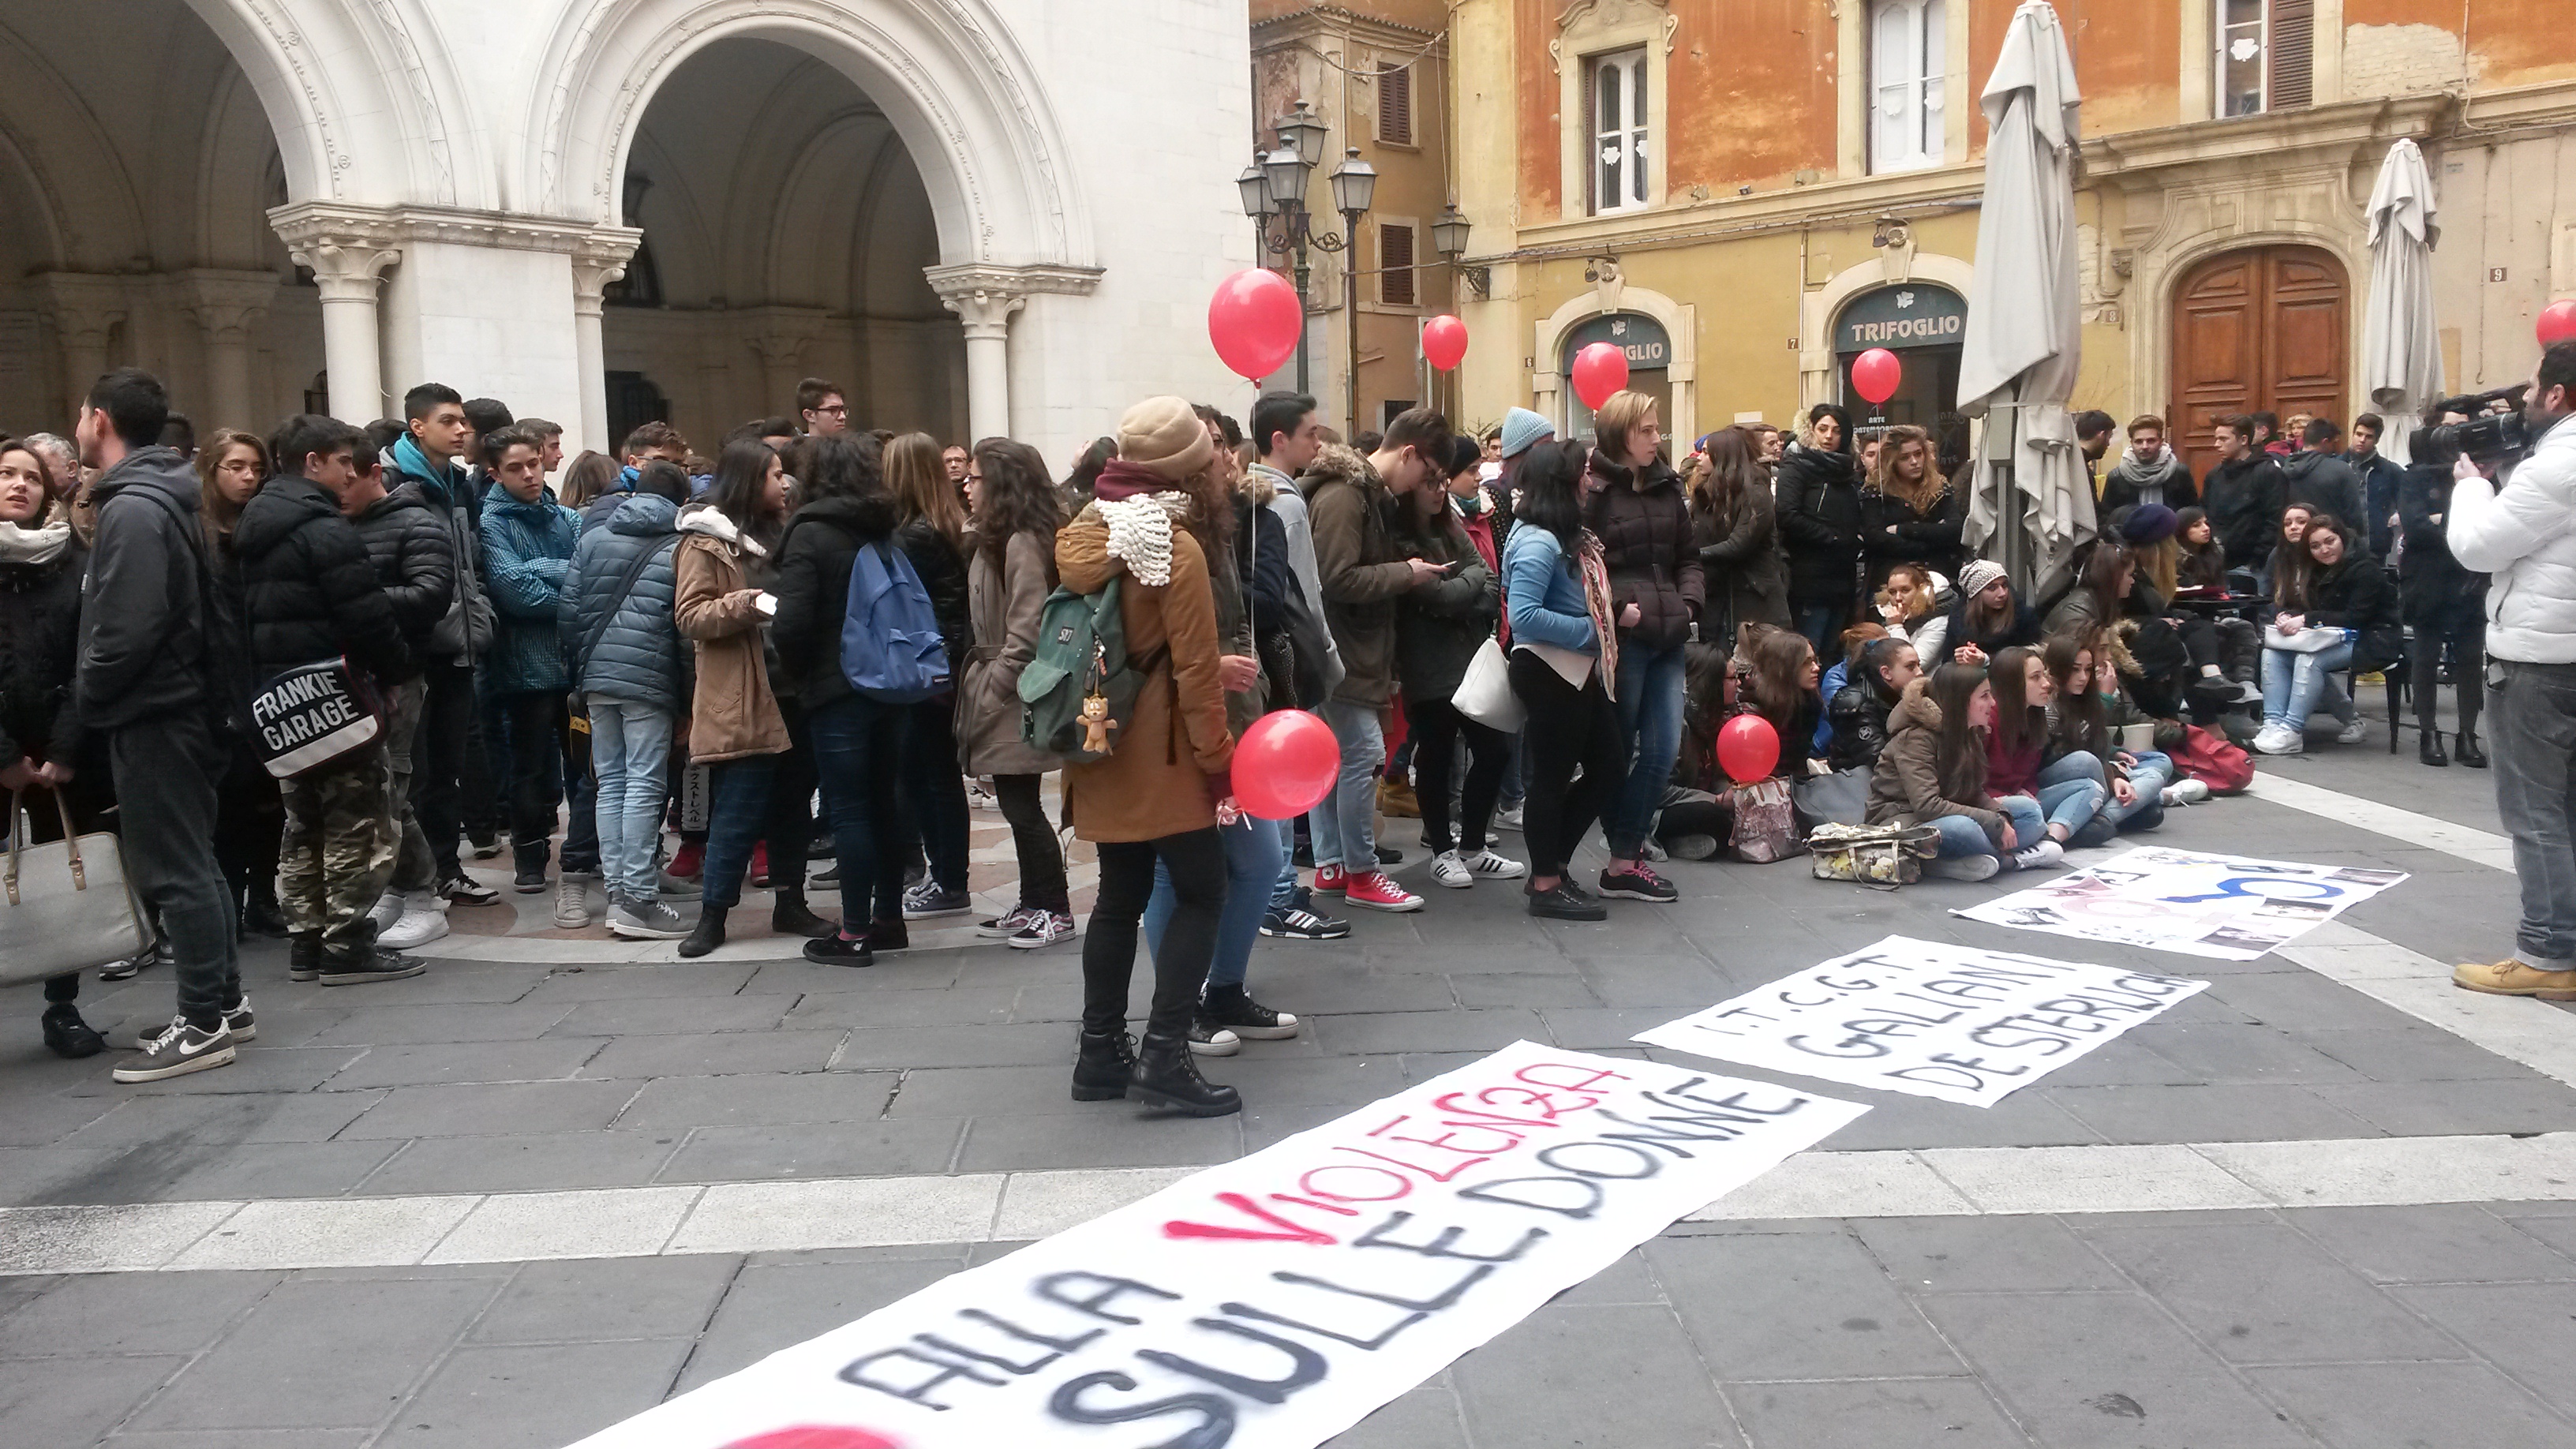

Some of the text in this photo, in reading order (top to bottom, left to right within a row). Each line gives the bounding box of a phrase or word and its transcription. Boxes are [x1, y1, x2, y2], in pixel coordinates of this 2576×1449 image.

[2495, 268, 2503, 281] 9
[1852, 315, 1960, 343] TRIFOGLIO
[2110, 311, 2116, 322] 8
[1527, 358, 1532, 367] 6
[1790, 339, 1796, 349] 7
[253, 672, 345, 728] FRANKIE
[263, 695, 359, 751] GARAGE
[1784, 955, 2077, 1058] GALIANI
[1881, 1053, 2031, 1091] DE
[838, 1063, 1634, 1411] ALLA VIOLENZA
[1048, 1075, 1810, 1449] SULLE DONNE
